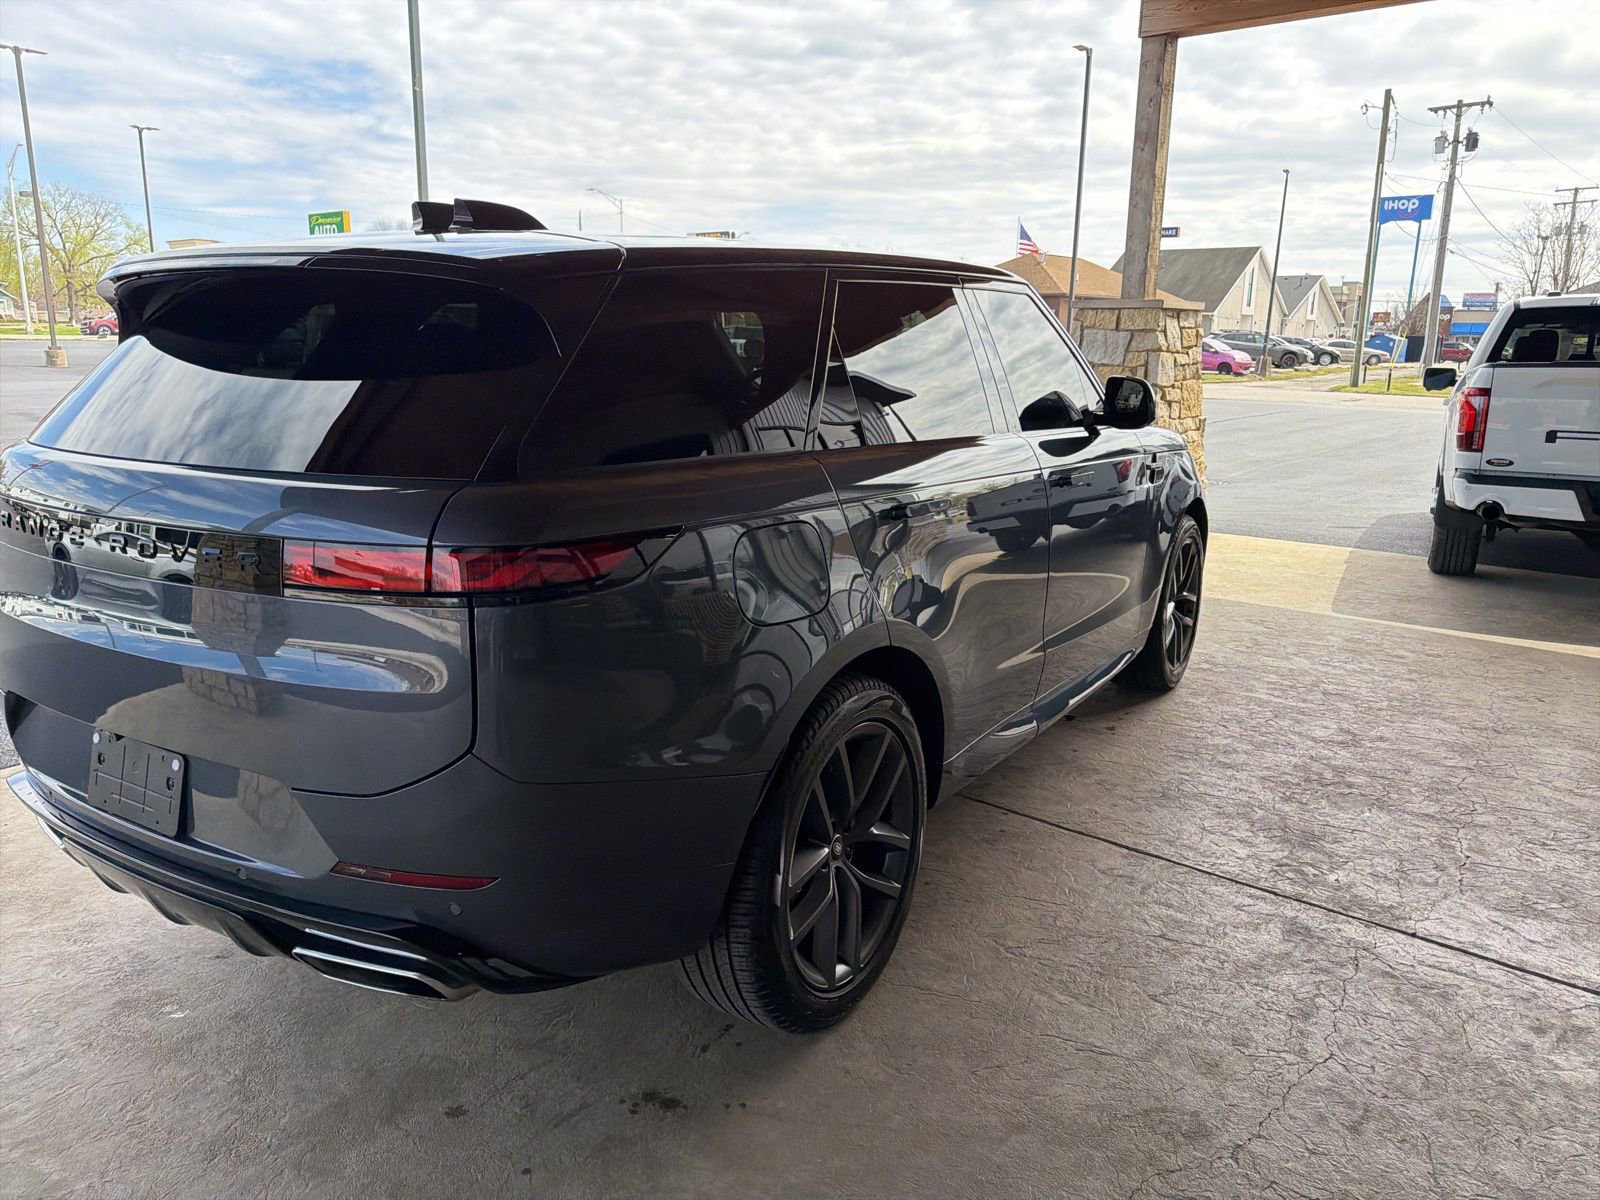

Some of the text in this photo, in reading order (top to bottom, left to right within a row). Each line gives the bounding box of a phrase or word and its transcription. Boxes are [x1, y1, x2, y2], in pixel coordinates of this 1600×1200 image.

[310, 216, 341, 227] Premier
[314, 224, 338, 235] AUTO
[1, 510, 261, 576] RANGE ROVER
